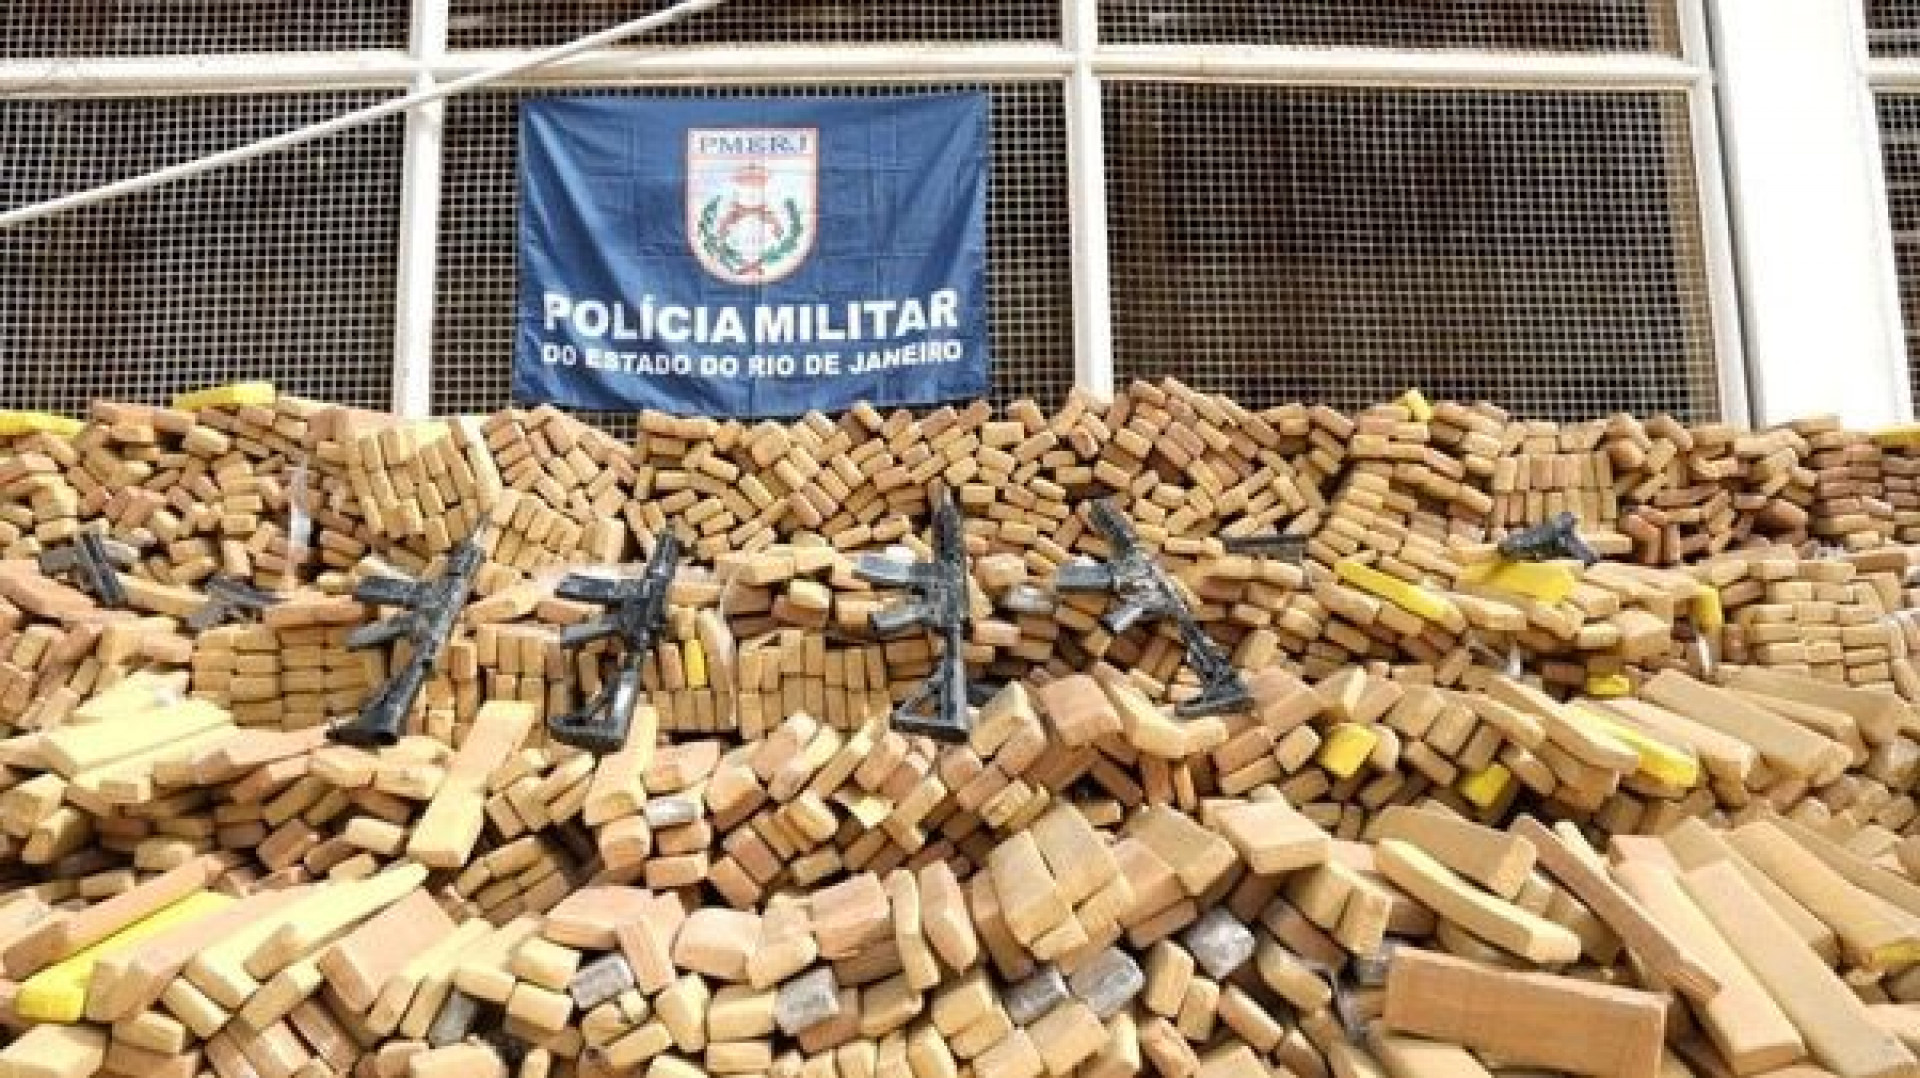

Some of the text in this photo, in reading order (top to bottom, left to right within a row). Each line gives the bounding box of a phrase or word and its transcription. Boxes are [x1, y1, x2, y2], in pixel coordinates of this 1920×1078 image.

[699, 135, 807, 153] PMERJ
[543, 290, 958, 342] POLÍCIA MILITAR
[542, 341, 962, 377] DO ESTADO DO RIO DE JANEIRO
